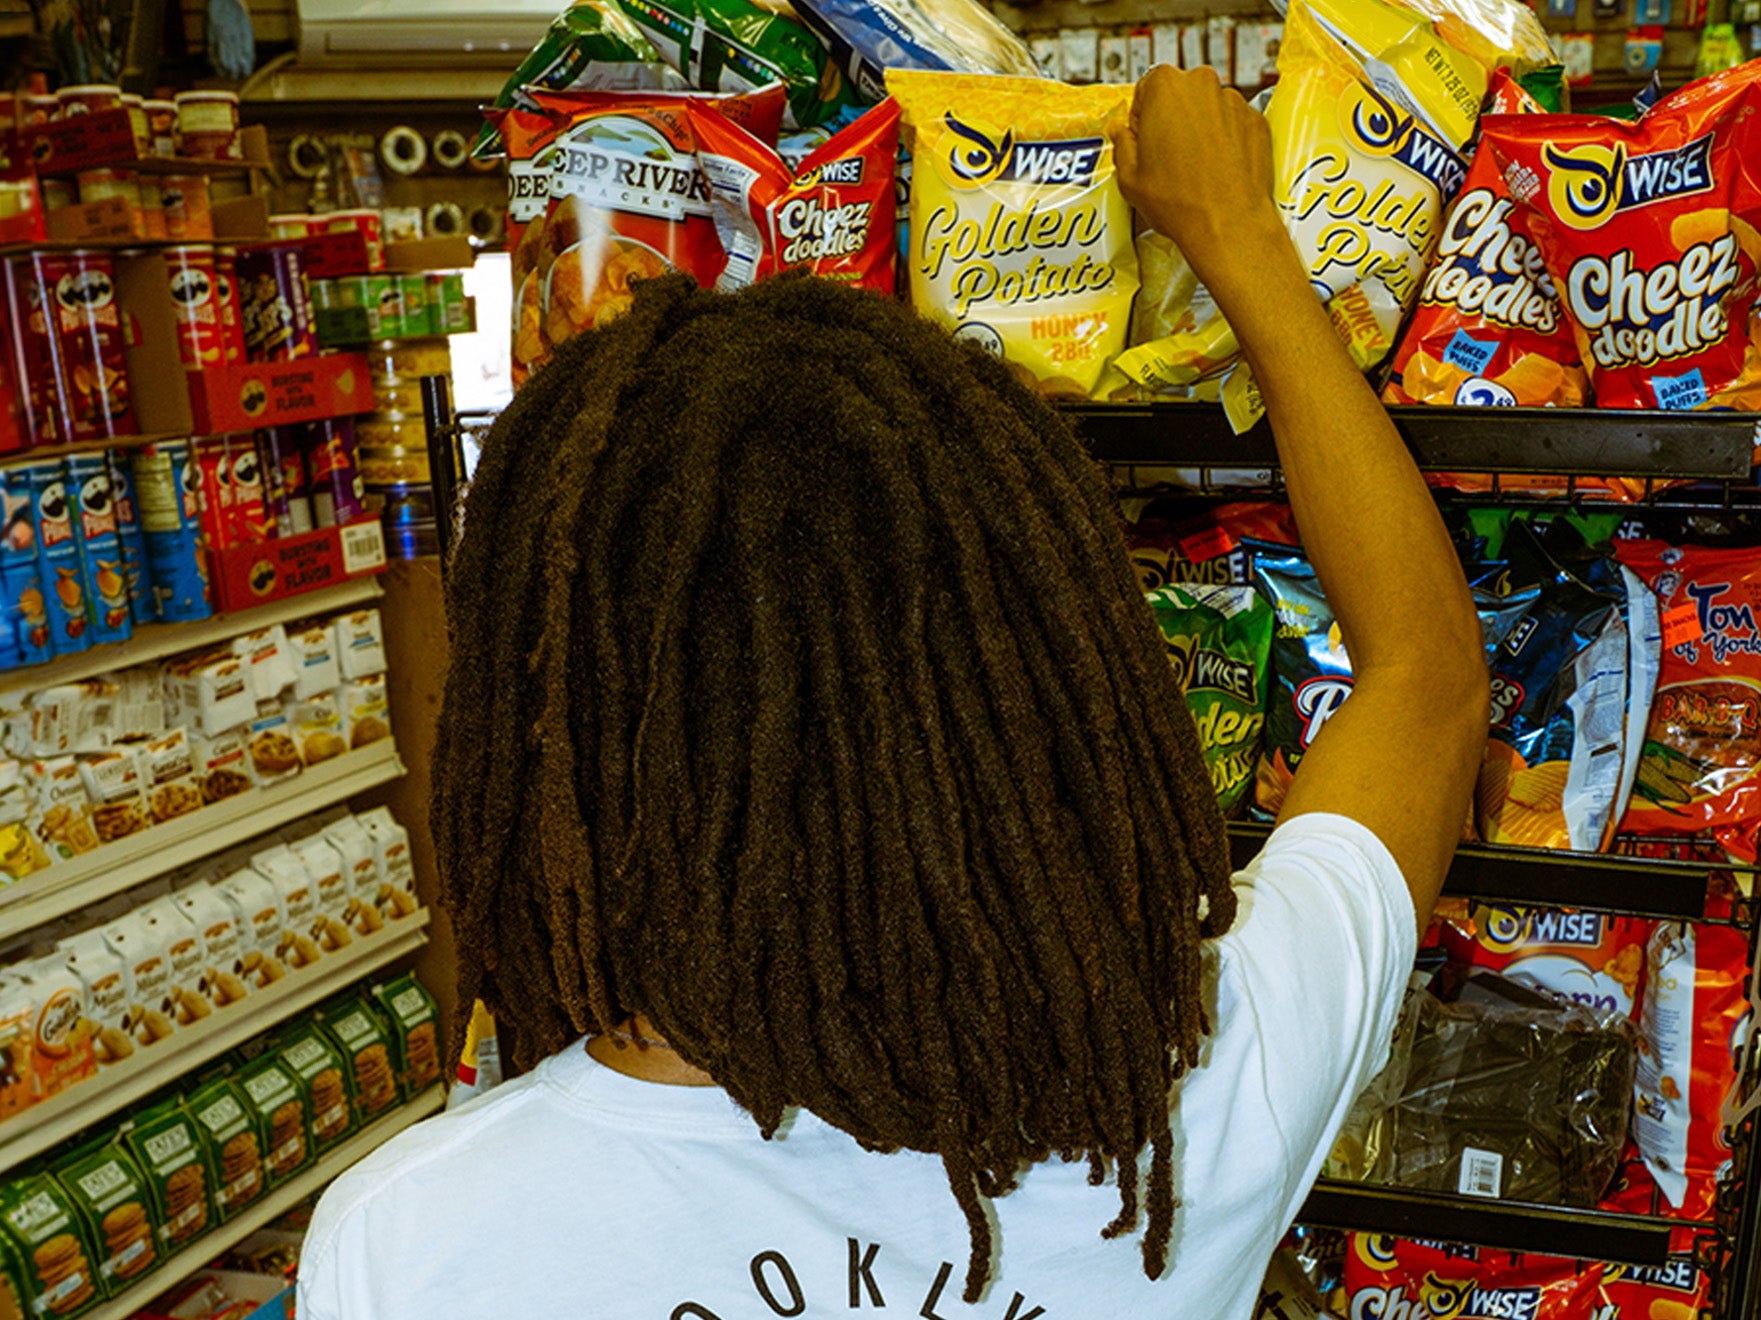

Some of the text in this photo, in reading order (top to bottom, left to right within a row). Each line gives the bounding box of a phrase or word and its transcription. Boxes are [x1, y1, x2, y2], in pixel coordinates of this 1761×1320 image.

[554, 147, 609, 179] EEP
[613, 157, 711, 202] RIVER
[822, 160, 861, 182] WISE
[1013, 146, 1096, 182] WISE
[1627, 146, 1704, 202] WISE
[508, 173, 553, 198] EE
[778, 197, 871, 239] Cheez
[782, 228, 868, 264] doodles
[920, 199, 1108, 280] Golden
[951, 253, 1116, 320] Potato
[1567, 231, 1740, 332] Cheez
[1591, 296, 1729, 369] doodle
[1180, 550, 1246, 584] WISE
[1197, 652, 1249, 698] WISE
[1660, 693, 1759, 730] BAR-B-Q
[1535, 912, 1596, 942] WISE
